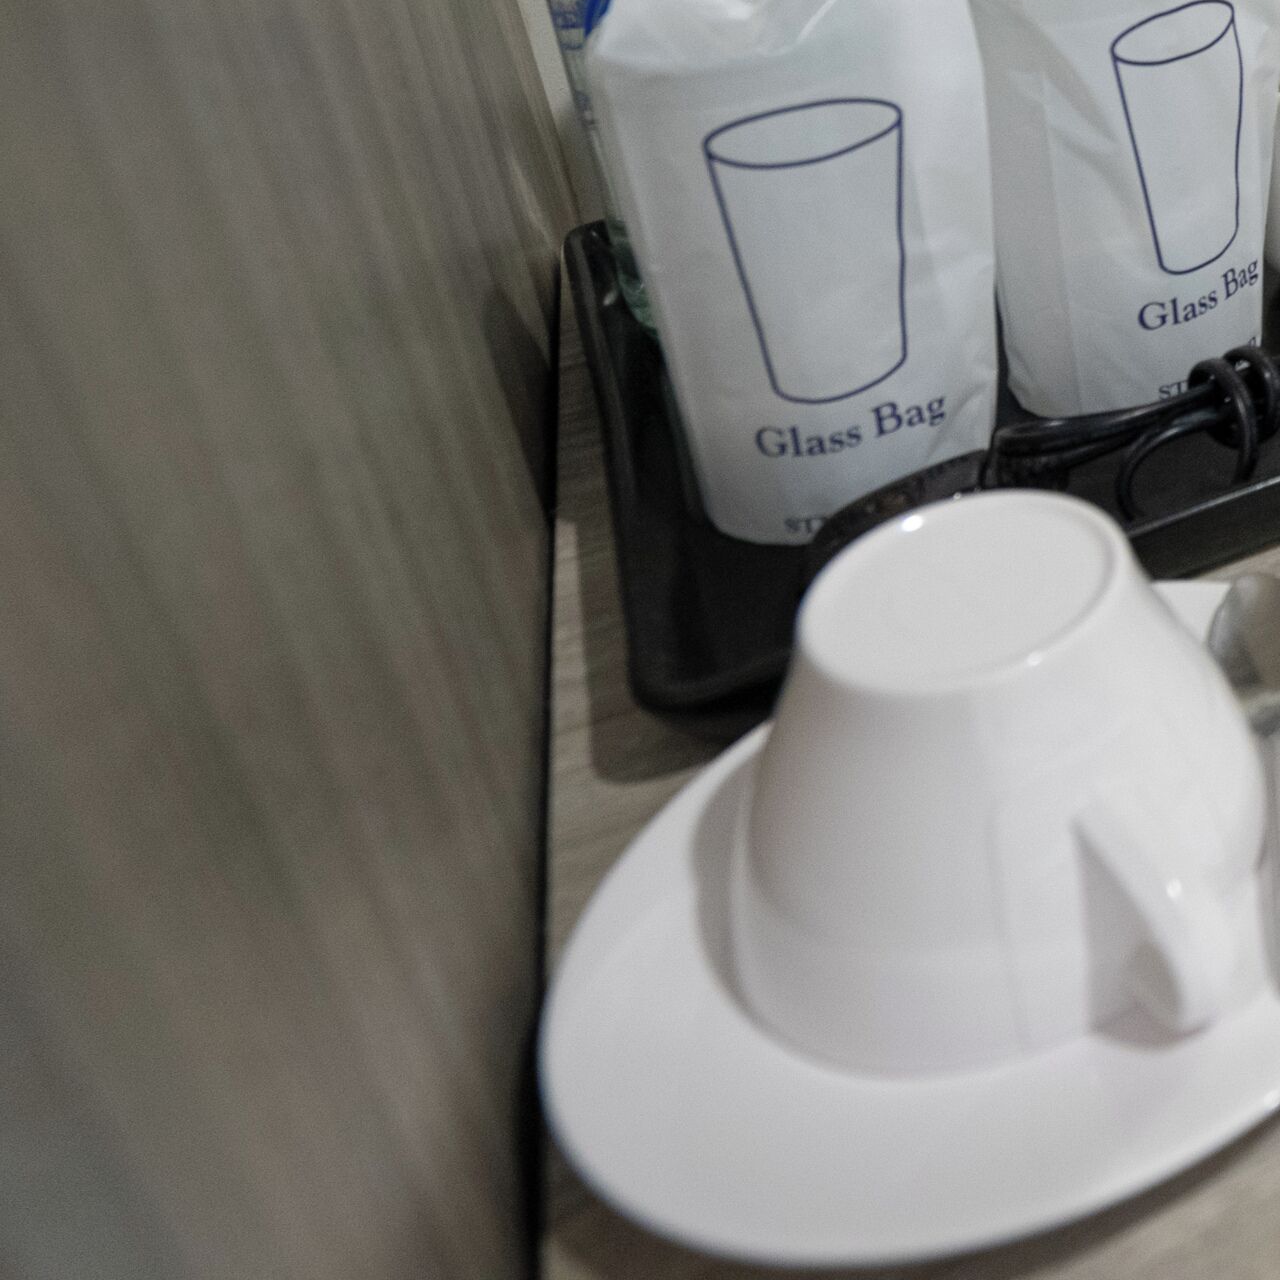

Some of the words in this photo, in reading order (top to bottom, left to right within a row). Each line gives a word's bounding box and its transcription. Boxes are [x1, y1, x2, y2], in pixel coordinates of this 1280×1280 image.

[1138, 290, 1218, 331] Glass
[1222, 259, 1259, 300] Bag
[755, 423, 862, 459] Glass
[871, 396, 946, 438] Bag
